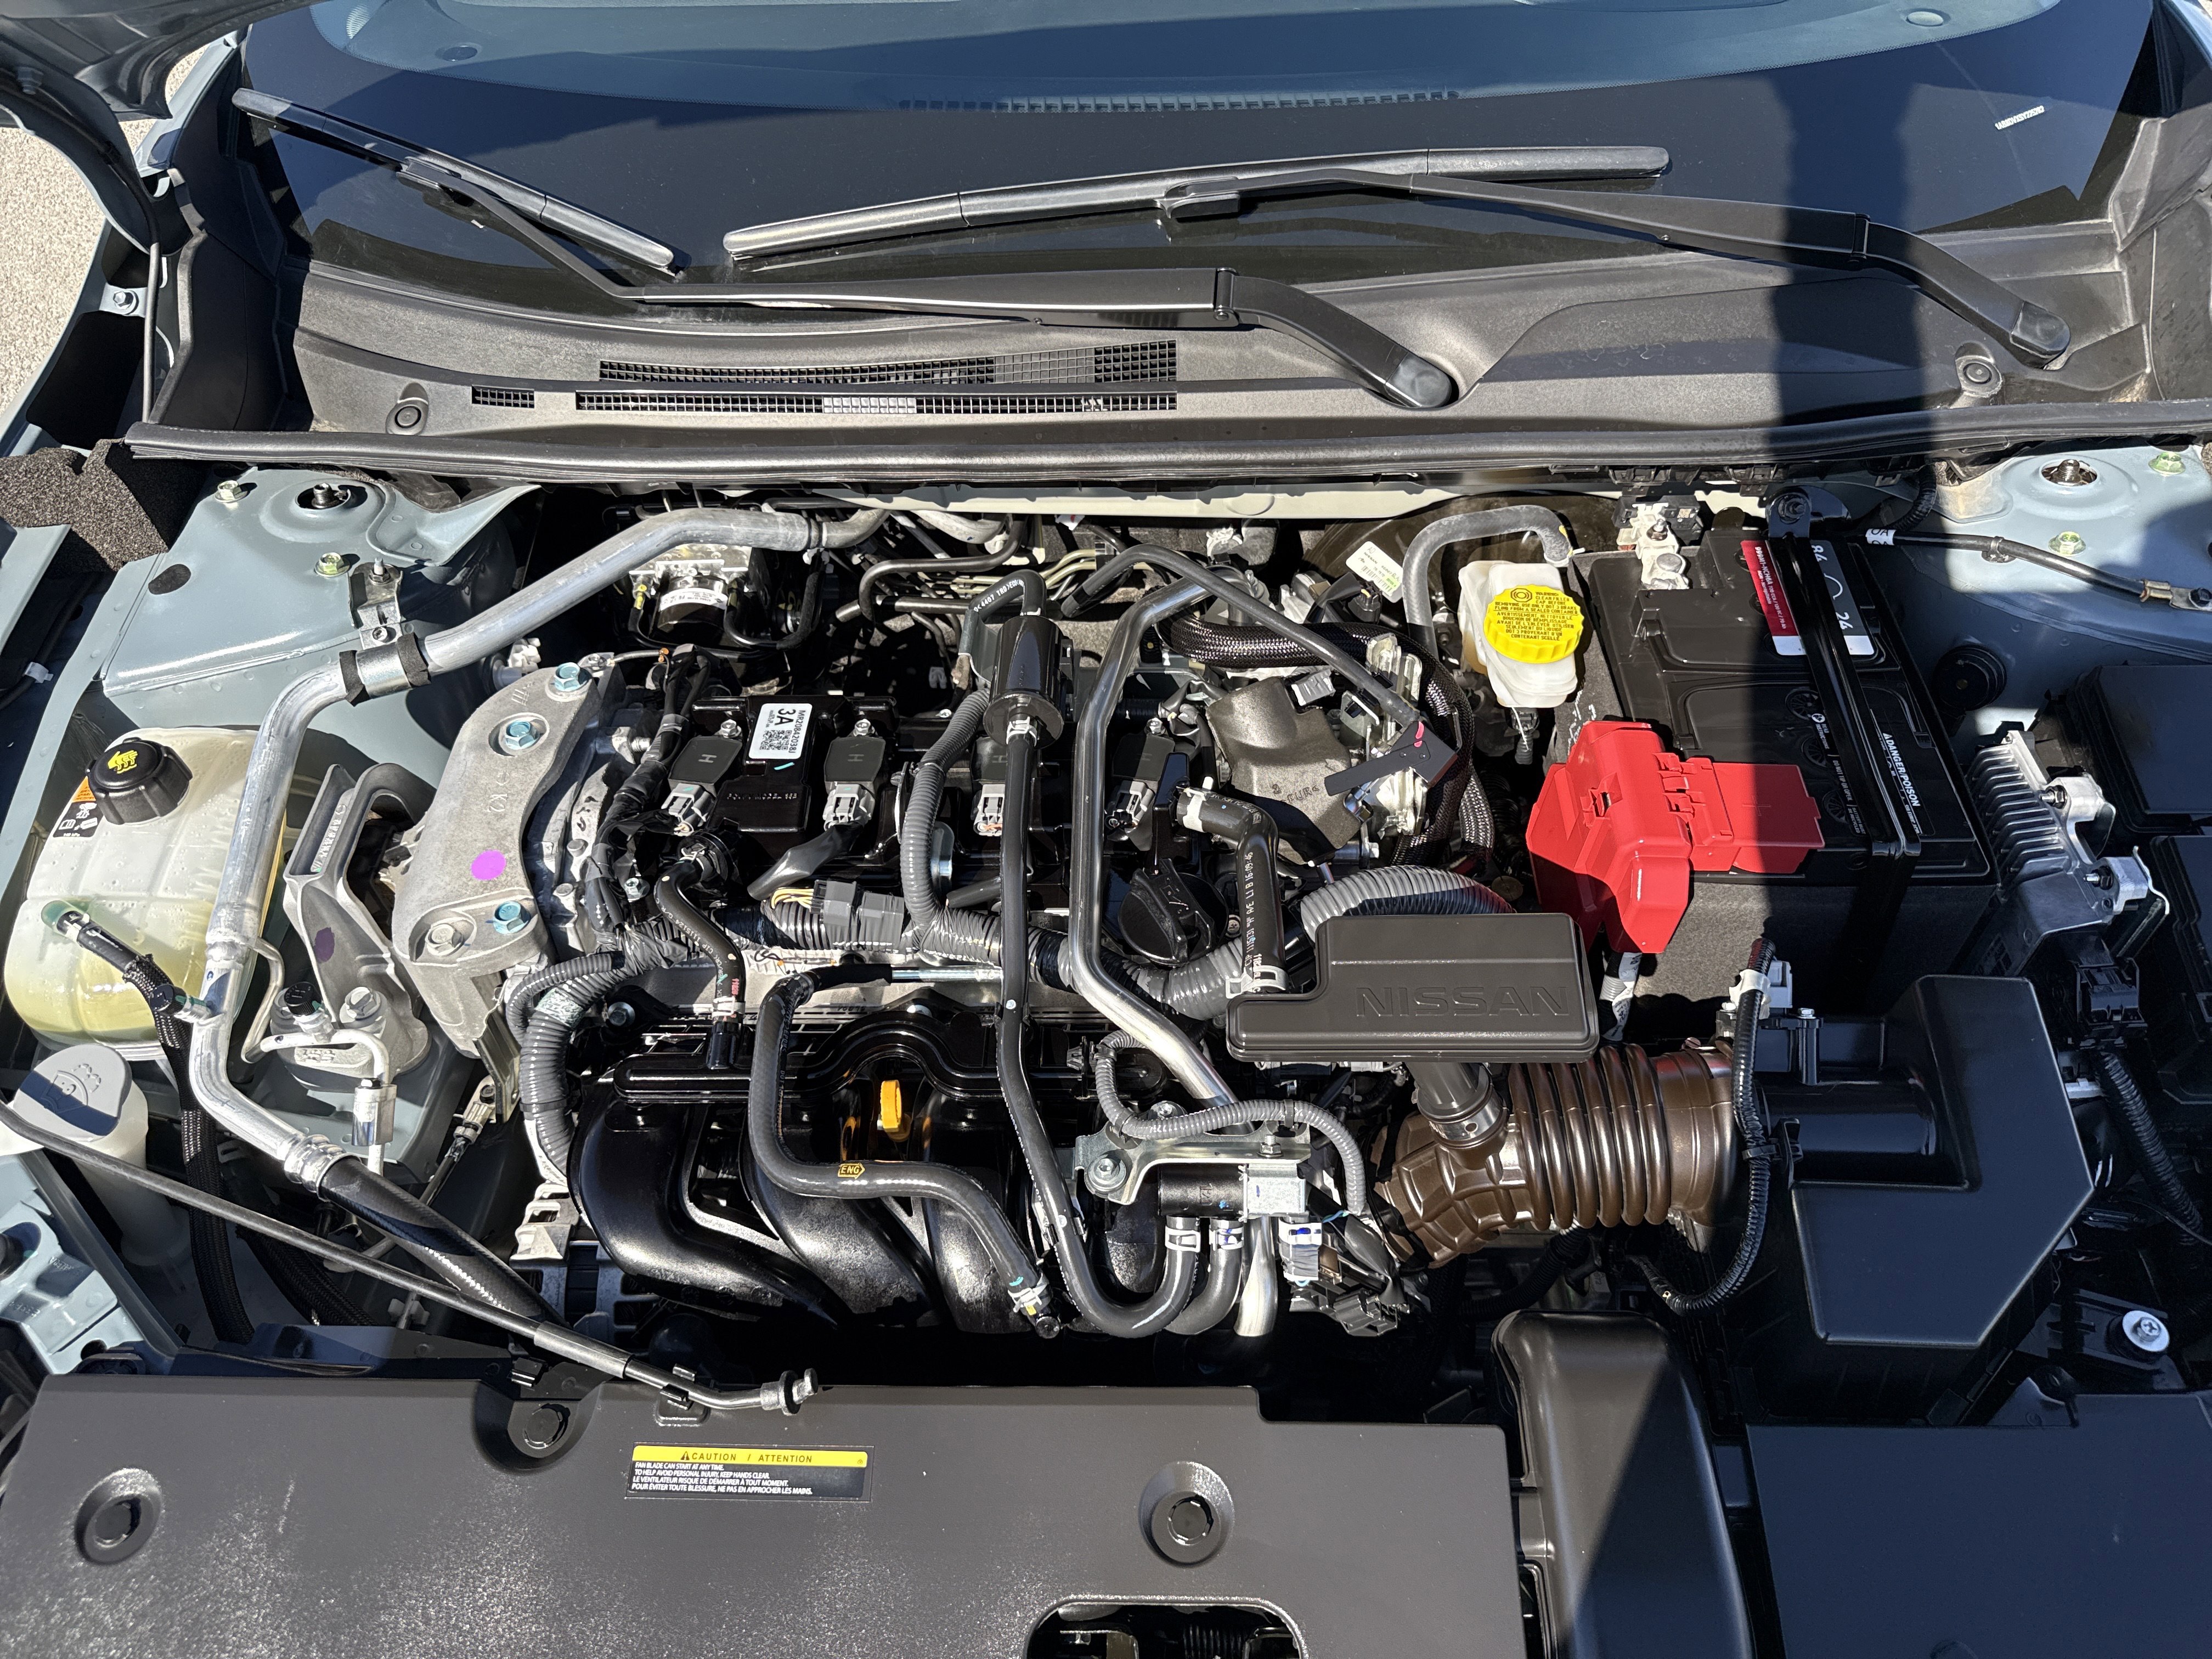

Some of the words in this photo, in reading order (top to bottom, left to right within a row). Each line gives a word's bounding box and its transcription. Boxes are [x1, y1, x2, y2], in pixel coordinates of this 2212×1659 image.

[1836, 612, 1853, 630] 24
[774, 709, 796, 726] 3A
[1886, 740, 1920, 806] DANGER/POISON
[1356, 987, 1570, 1017] NISSAN
[841, 1165, 860, 1174] ENG
